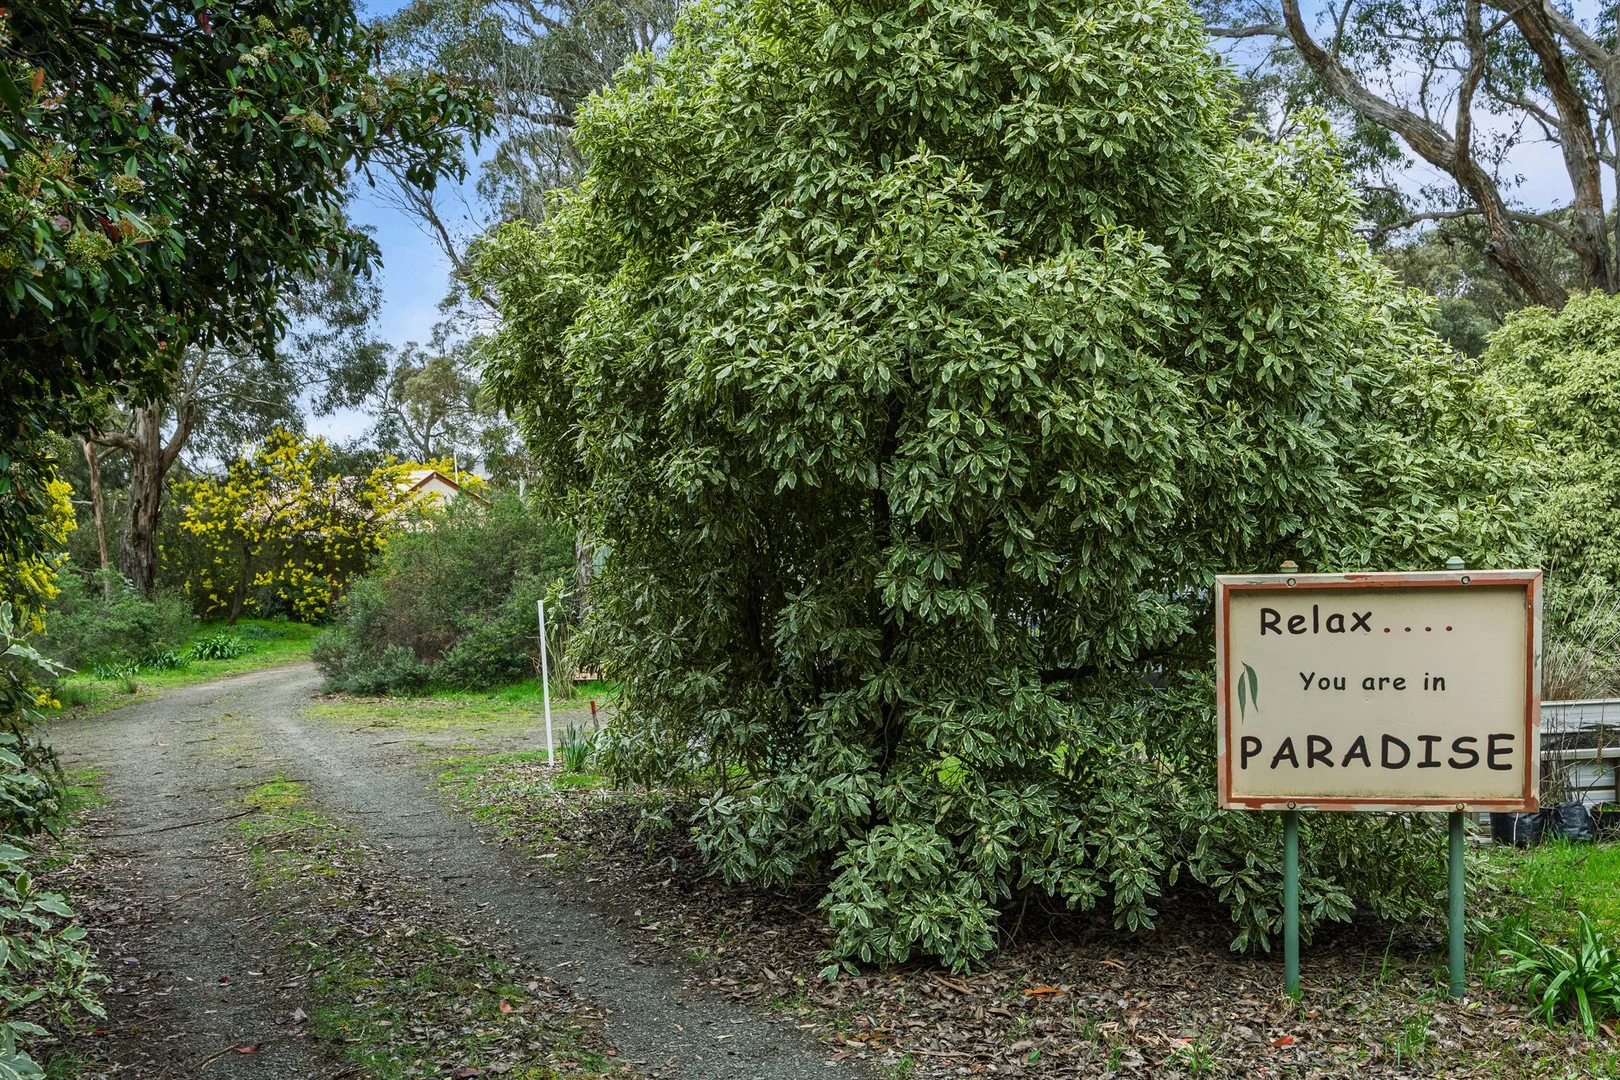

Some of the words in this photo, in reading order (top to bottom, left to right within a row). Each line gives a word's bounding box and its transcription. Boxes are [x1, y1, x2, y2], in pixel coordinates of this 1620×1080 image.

[1299, 671, 1346, 691] You
[1361, 676, 1407, 691] are
[1423, 672, 1446, 691] in
[1240, 733, 1516, 771] PARADISE
